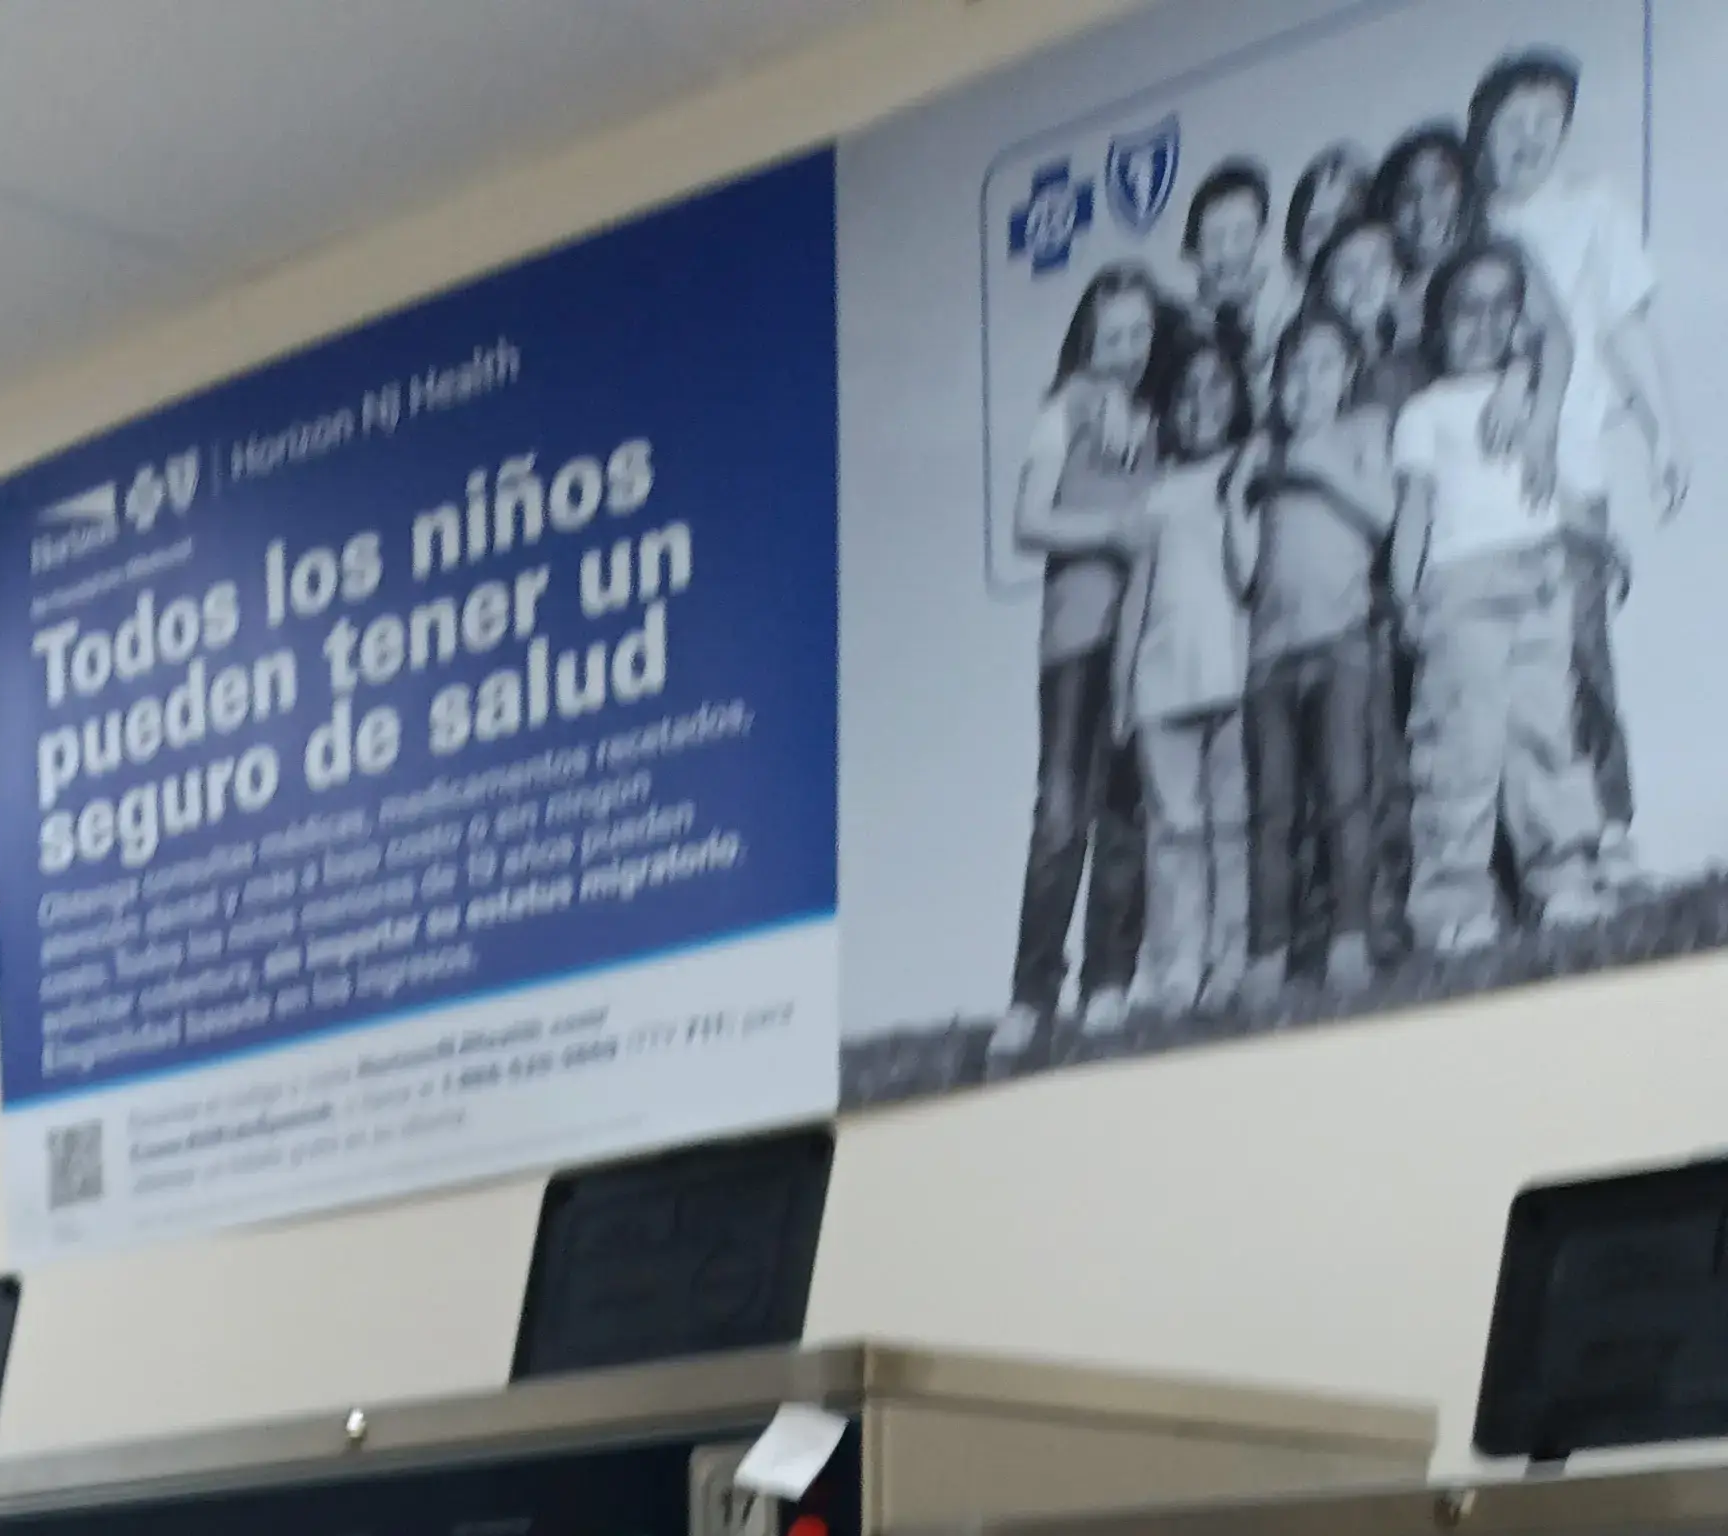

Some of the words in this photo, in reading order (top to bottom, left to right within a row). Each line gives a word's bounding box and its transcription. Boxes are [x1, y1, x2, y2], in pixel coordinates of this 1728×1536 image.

[32, 580, 241, 708] Todos
[265, 533, 383, 628] los
[412, 437, 655, 581] niños
[37, 645, 298, 810] pueden
[322, 562, 551, 695] tener
[578, 519, 694, 616] un
[38, 744, 281, 873] seguro
[303, 693, 402, 792] de
[428, 601, 669, 756] salud
